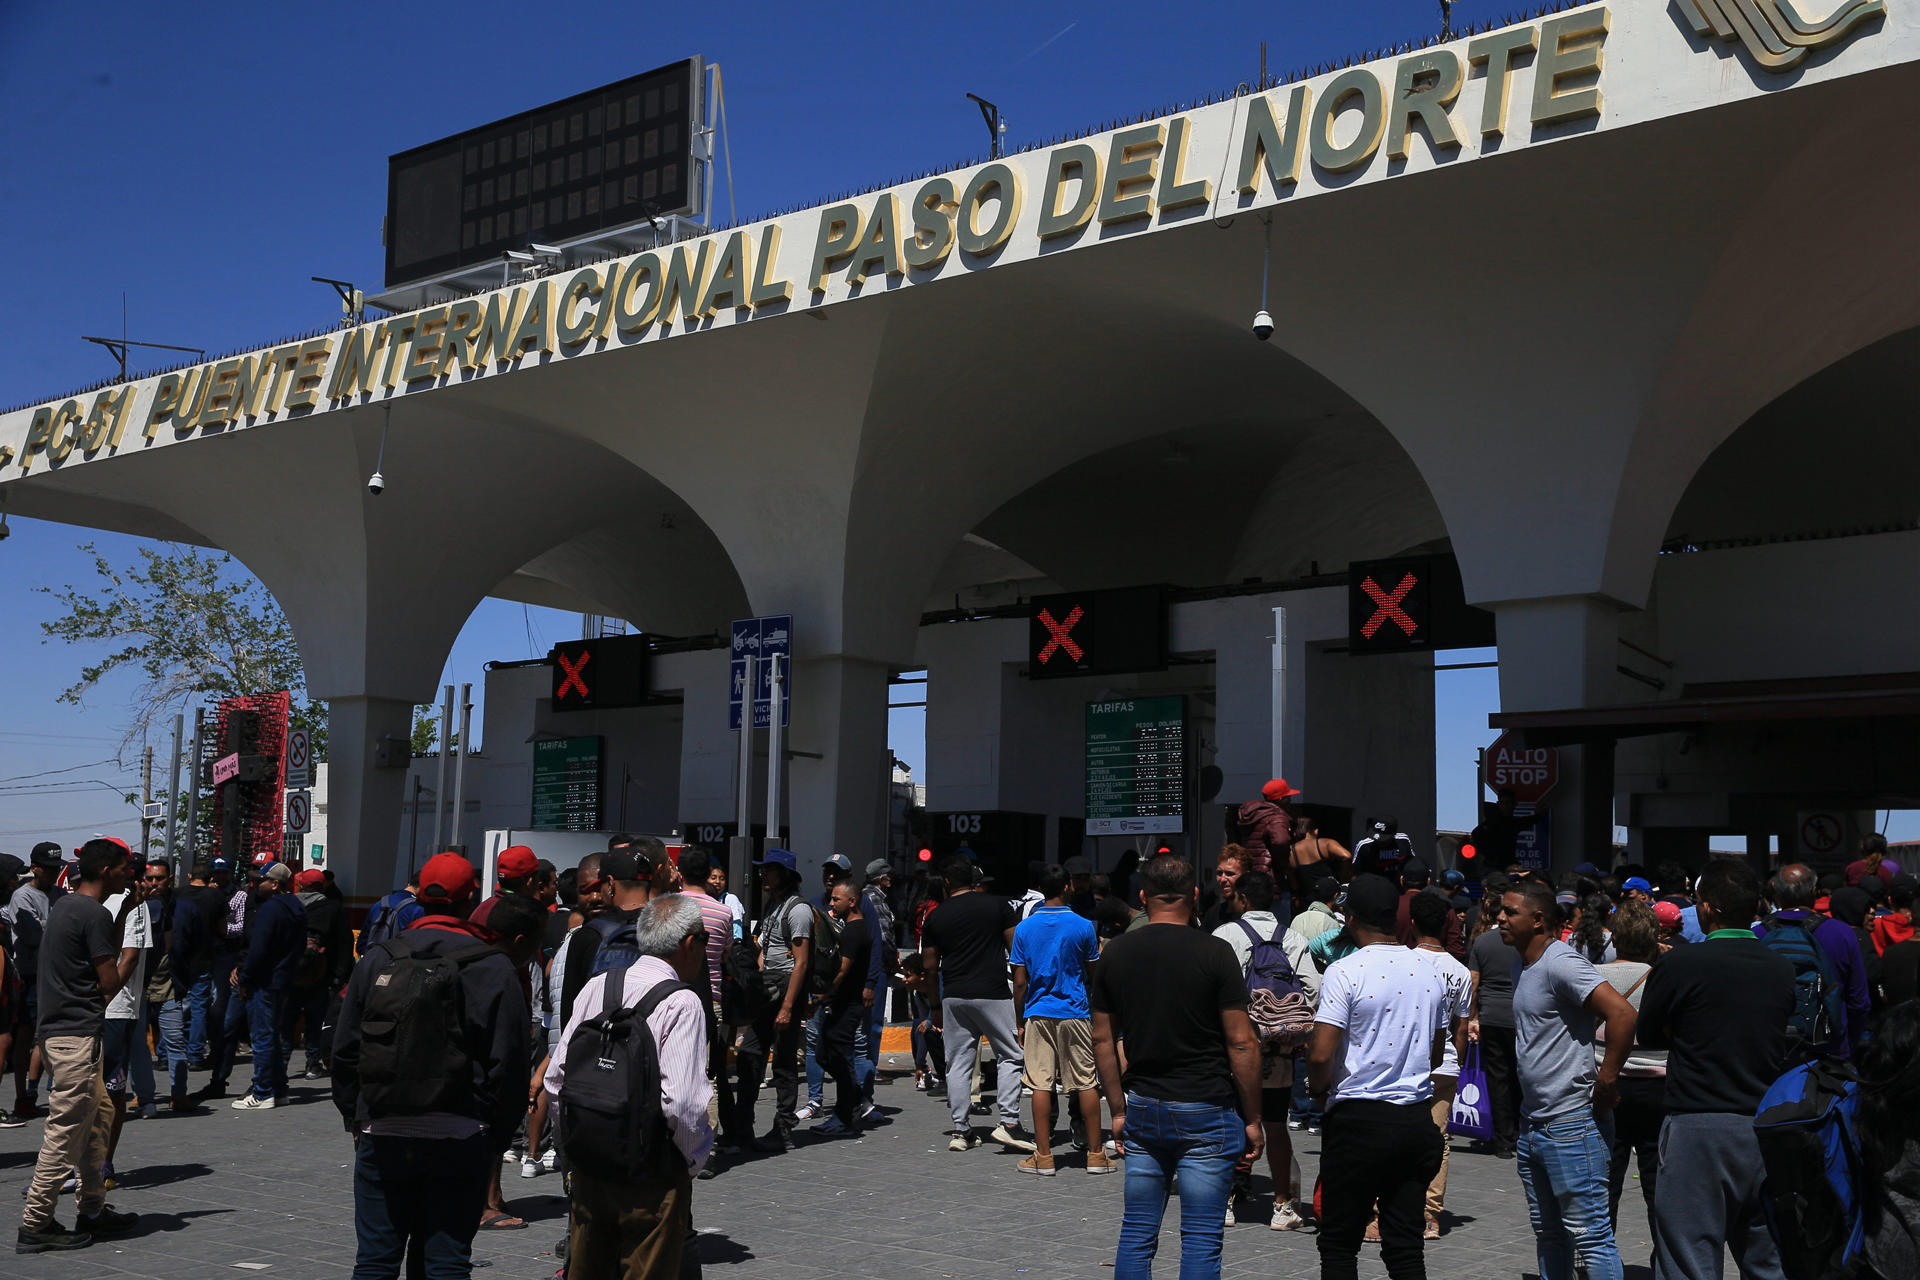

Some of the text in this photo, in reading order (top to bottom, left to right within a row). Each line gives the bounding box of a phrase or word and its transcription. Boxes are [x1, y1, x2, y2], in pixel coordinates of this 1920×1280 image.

[142, 338, 335, 439] PUENTE
[326, 224, 794, 400] INTERNACIONAL
[808, 164, 1023, 293] PASO
[1037, 117, 1212, 241] DEL
[1236, 7, 1611, 195] NORTE
[1091, 702, 1135, 714] TARIFAS
[539, 741, 568, 751] TARIFAS
[1497, 748, 1547, 764] ALTO
[1495, 769, 1548, 785] STOP
[948, 814, 982, 834] 103
[697, 825, 724, 843] 102
[1379, 849, 1398, 861] NIKE
[1528, 849, 1541, 858] DE
